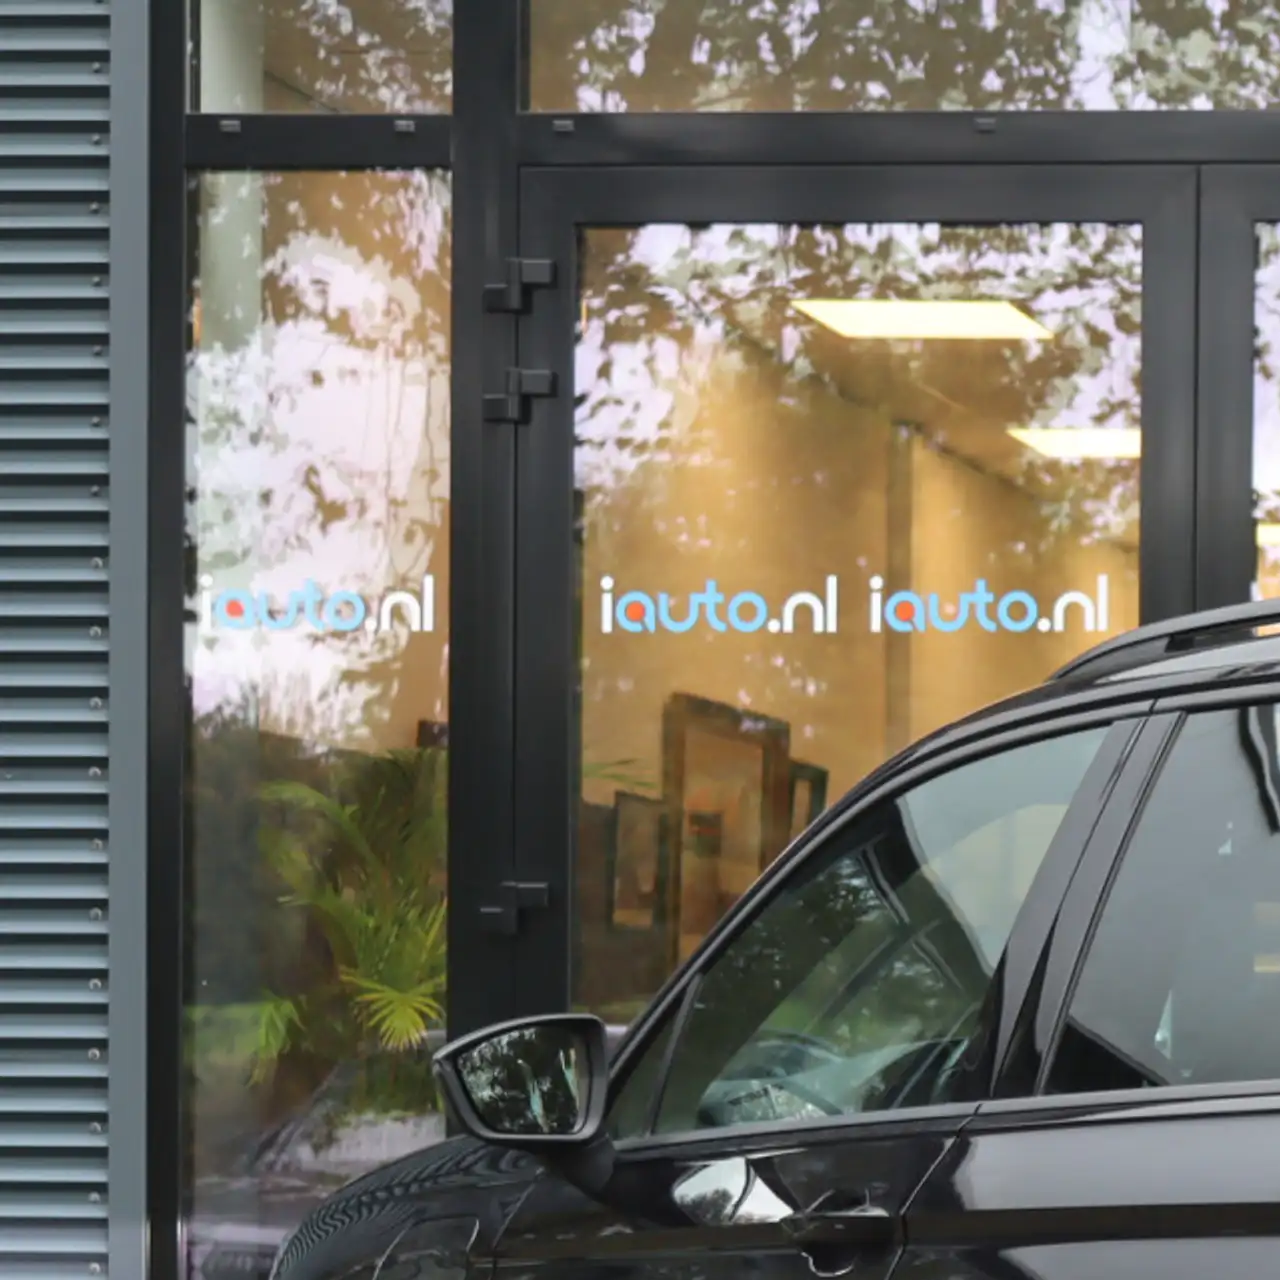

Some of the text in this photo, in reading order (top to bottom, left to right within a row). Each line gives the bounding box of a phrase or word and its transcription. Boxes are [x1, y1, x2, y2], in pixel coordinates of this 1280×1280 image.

[198, 573, 435, 633] iauto.nl
[600, 573, 838, 634] iauto.nl
[868, 573, 1108, 634] iauto.nl
